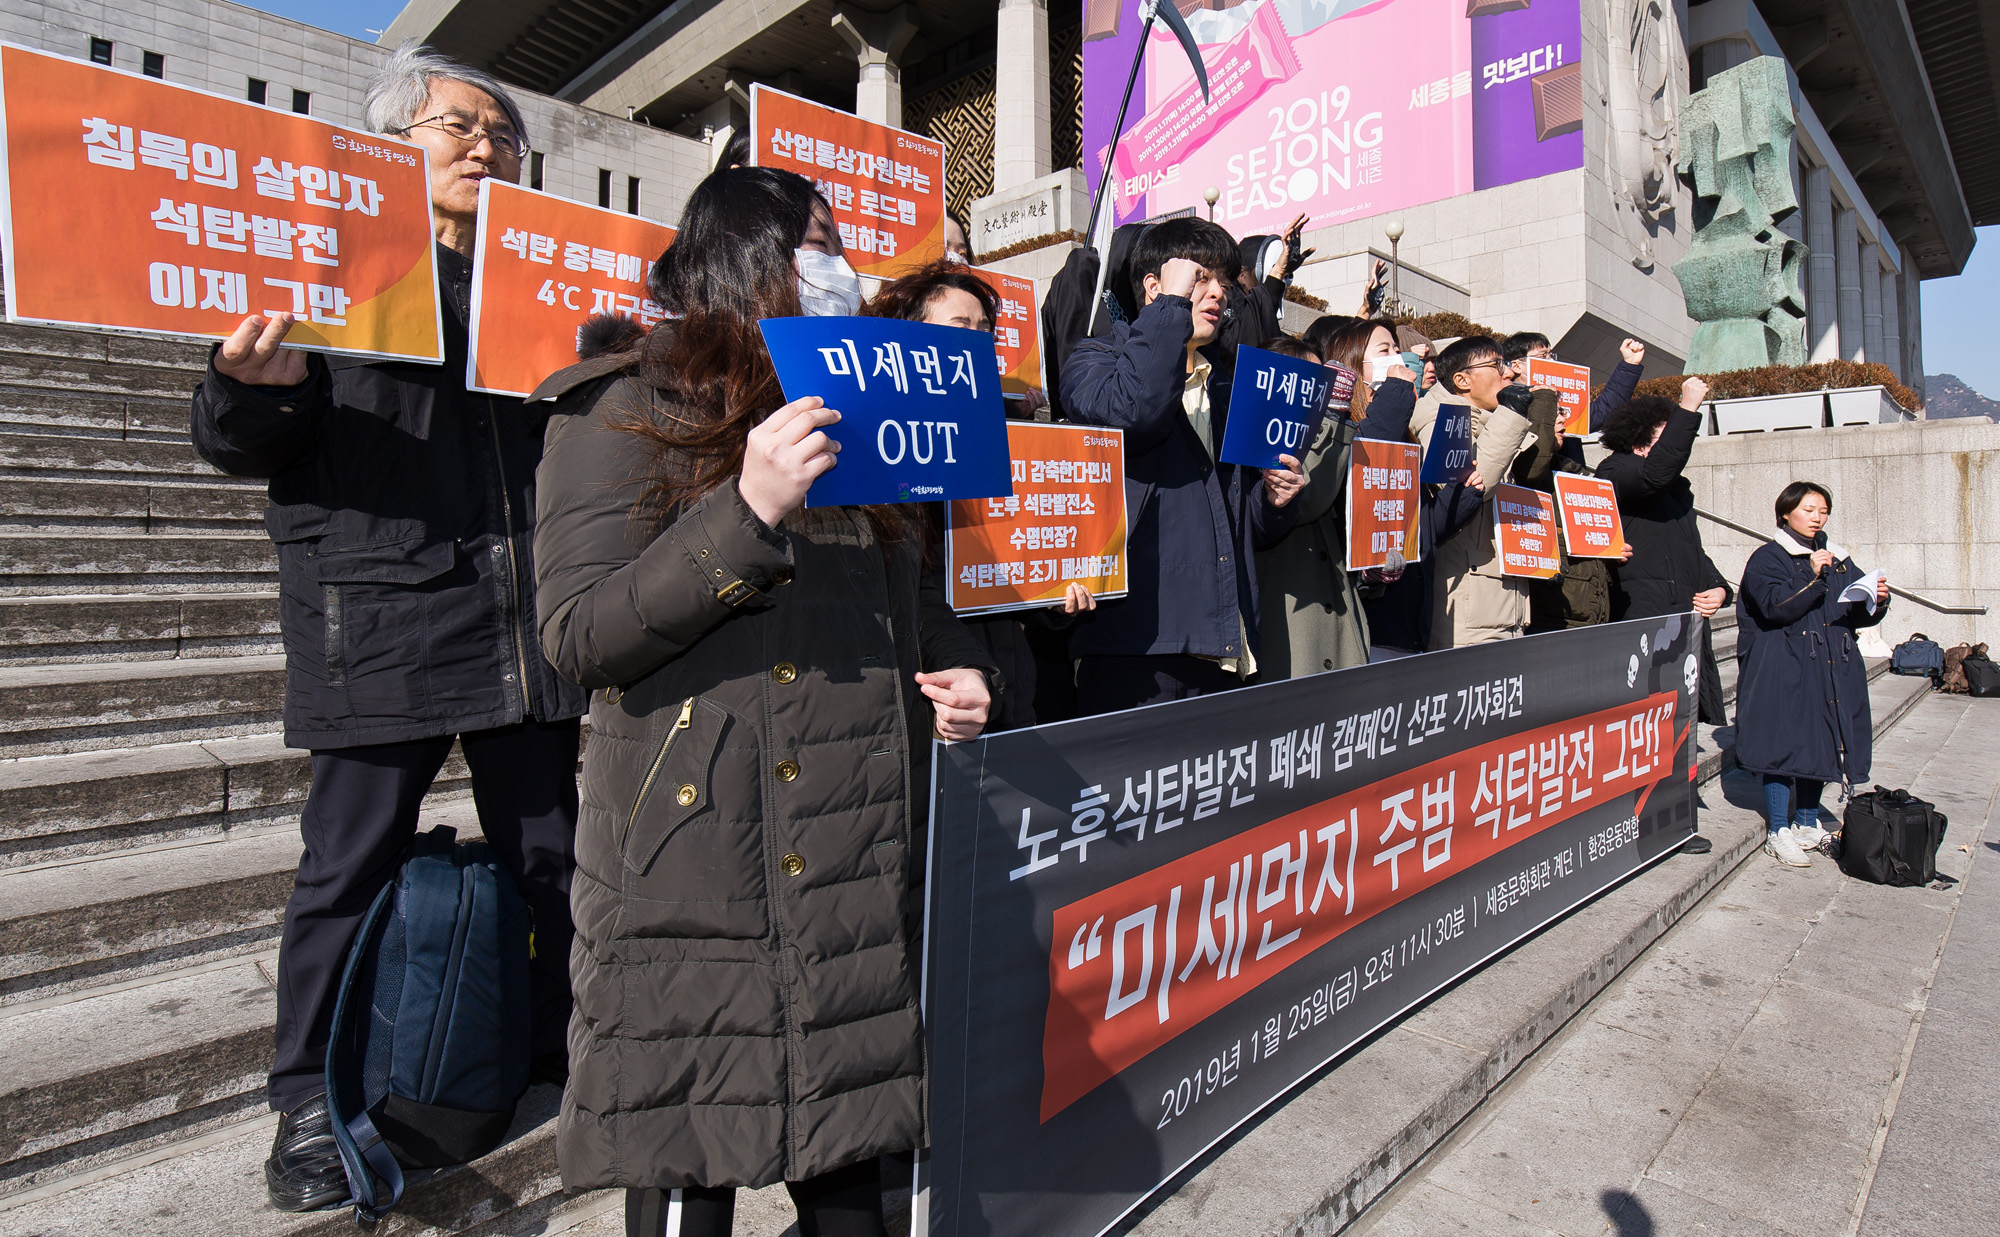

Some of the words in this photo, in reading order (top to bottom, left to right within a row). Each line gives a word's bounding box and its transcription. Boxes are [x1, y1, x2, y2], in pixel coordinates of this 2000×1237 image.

[1224, 56, 1239, 73] 오픈
[1237, 59, 1253, 76] 오픈
[1407, 70, 1472, 111] 세종을
[1482, 43, 1563, 91] 맛보다!
[1230, 79, 1246, 97] 오픈
[1267, 84, 1351, 142] 2019
[347, 138, 417, 167] 환경운동연합
[770, 127, 931, 195] 산업통상자원부는
[1226, 111, 1384, 187] SEJONG
[1356, 146, 1383, 170] 세종
[81, 116, 239, 191] 침묵의
[251, 156, 385, 218] 살인자
[1125, 163, 1182, 198] 테이스트
[1356, 165, 1383, 188] 시즌
[1212, 155, 1351, 223] SEASON
[859, 188, 917, 227] 로드맵
[150, 197, 340, 268] 석탄발전
[500, 227, 558, 266] 석탄
[563, 241, 642, 284] 중독에
[148, 261, 249, 316] 이제
[263, 276, 351, 327] 그만
[817, 338, 979, 400] 미세먼지
[1256, 366, 1329, 413] 미세먼지
[1265, 417, 1310, 450] OUT
[1444, 415, 1471, 439] 미세먼
[877, 418, 959, 466] OUT
[1030, 459, 1112, 484] 감축한다면서
[1445, 449, 1469, 469] OUT
[1362, 465, 1389, 490] 침묵의
[1389, 468, 1413, 491] 살인자
[988, 494, 1021, 518] 노후
[1023, 493, 1096, 517] 석탄발전소
[1373, 499, 1405, 522] 석탄발전
[1500, 500, 1523, 516] 미세먼지
[1564, 491, 1614, 511] 산업통상자원부는
[1511, 519, 1522, 532] 노후
[1522, 521, 1548, 537] 석탄발전소
[1573, 511, 1594, 527] 탈석탄
[1592, 513, 1613, 529] 로드맵
[1009, 525, 1078, 551] 수명연장?
[1371, 531, 1388, 554] 이제
[1388, 530, 1405, 552] 그만
[1519, 537, 1543, 553] 수명연장?
[1585, 531, 1610, 546] 수립하라
[959, 560, 1025, 589] 석탄발전
[1028, 558, 1058, 584] 조기
[1060, 554, 1119, 581] 폐쇄하라!
[1504, 552, 1527, 567] 석탄발전
[1527, 555, 1538, 568] 조기
[1009, 739, 1258, 882] 노후석탄발전
[1268, 722, 1326, 790] 폐쇄
[1332, 702, 1403, 773] 캠페인
[1407, 693, 1448, 748] 선포
[1453, 674, 1524, 732] 기자회견
[1067, 807, 1359, 1025] “미세먼지
[1372, 769, 1457, 893] 주범
[1470, 732, 1595, 841] 석탄발전
[1602, 702, 1675, 784] 그만!”
[1156, 1039, 1241, 1131] 2019년
[1250, 1012, 1282, 1063] 1월
[1287, 965, 1358, 1041] 25일(금)
[1362, 944, 1396, 992] 오전
[1400, 922, 1432, 967] 11시
[1435, 903, 1466, 947] 30분
[1485, 858, 1551, 916] 세종문화회관
[1553, 846, 1574, 879] 계단
[1588, 815, 1640, 862] 환경운동연합
